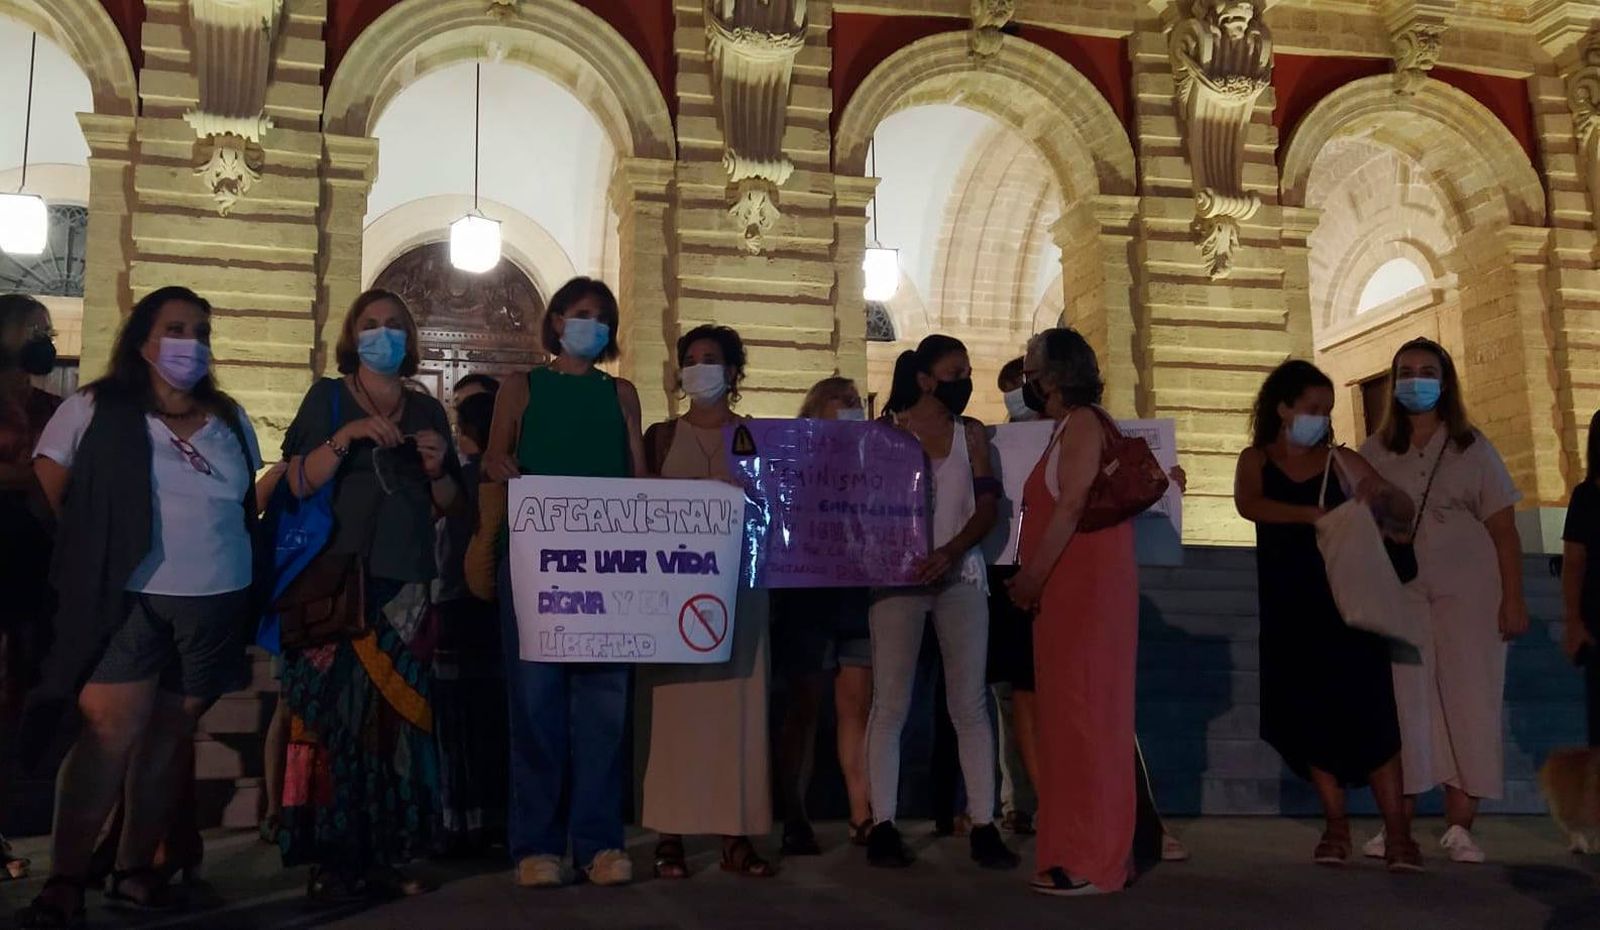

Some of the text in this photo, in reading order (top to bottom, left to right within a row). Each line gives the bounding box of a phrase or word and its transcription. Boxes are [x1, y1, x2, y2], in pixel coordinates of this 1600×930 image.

[512, 493, 738, 534] AFGANISTAN:
[540, 543, 720, 575] POR UNA VIDA
[538, 585, 606, 615] DIGNA
[611, 590, 634, 616] Y
[538, 625, 657, 658] LIBERTAD
